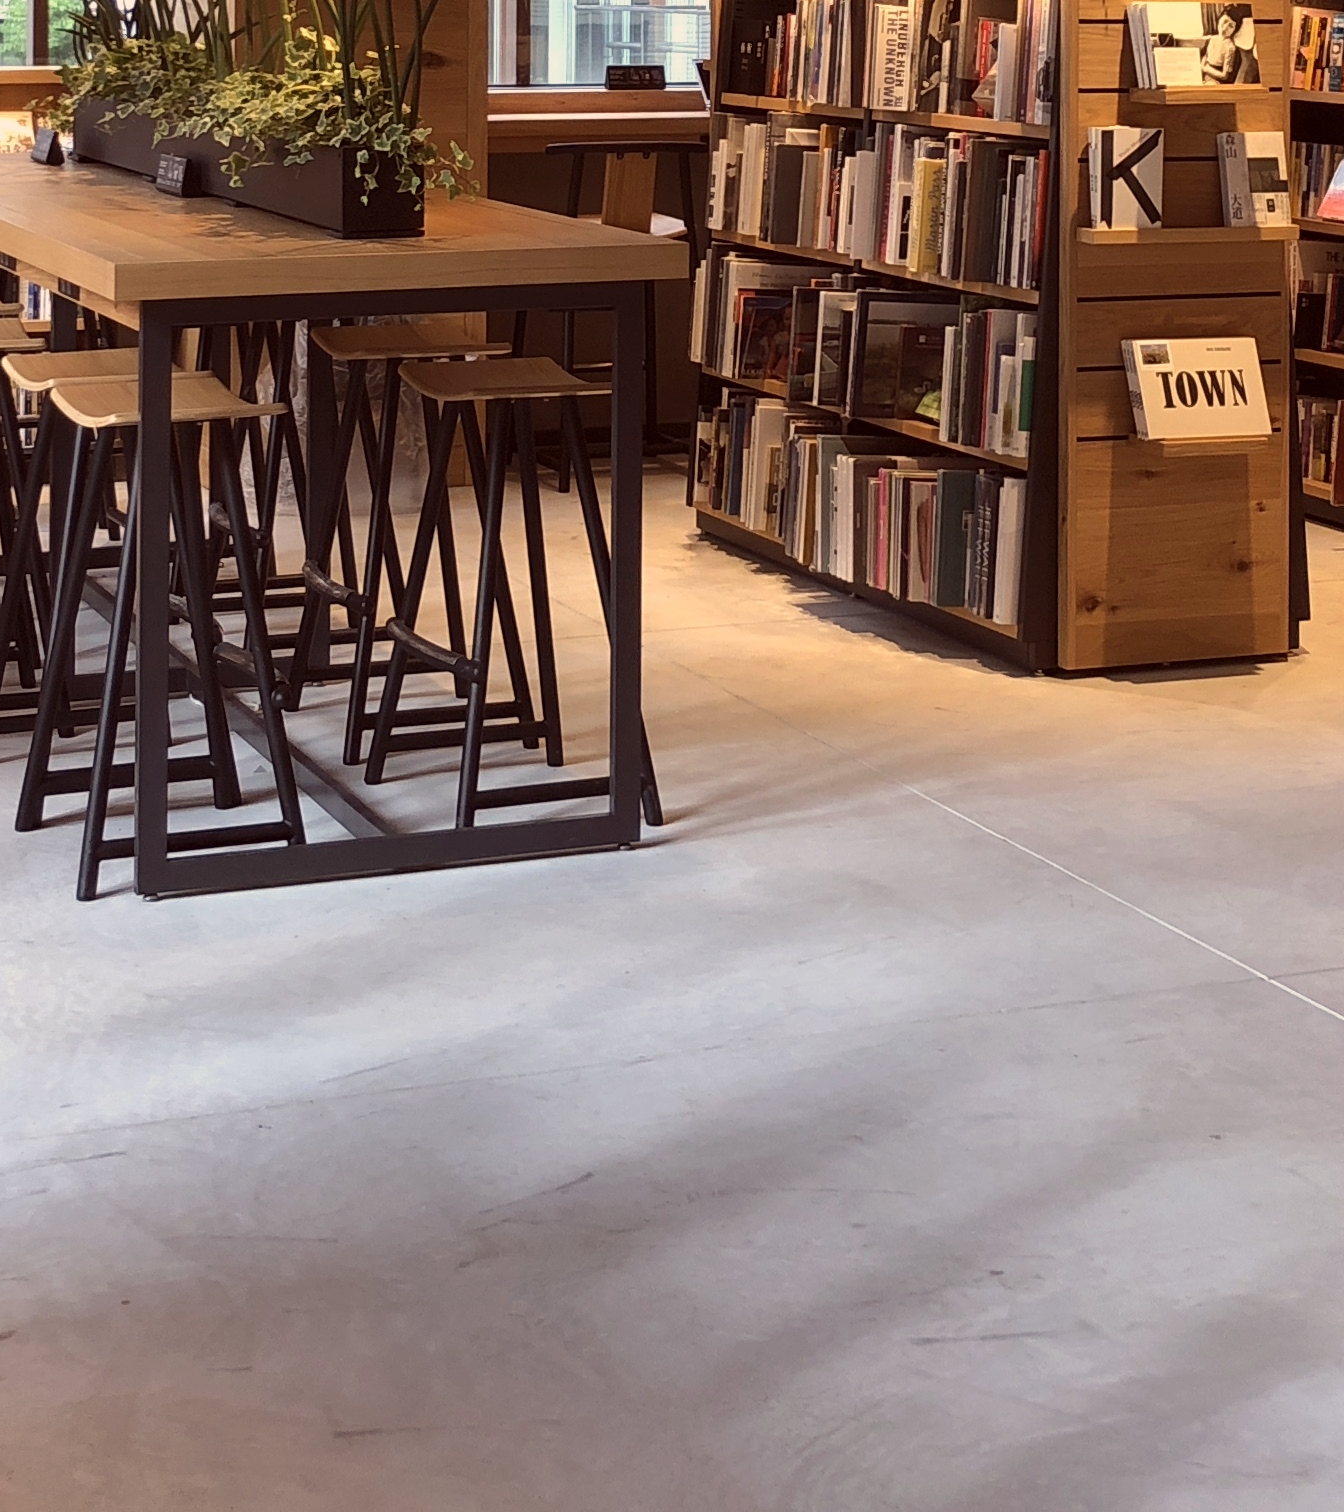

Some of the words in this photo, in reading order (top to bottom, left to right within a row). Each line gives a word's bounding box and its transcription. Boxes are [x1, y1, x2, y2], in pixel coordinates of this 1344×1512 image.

[886, 10, 898, 35] THE
[883, 38, 896, 107] UNKNOWN
[1225, 133, 1238, 159] 森山
[1100, 129, 1163, 229] K
[1231, 194, 1244, 220] 大道
[1155, 369, 1249, 409] TOWN
